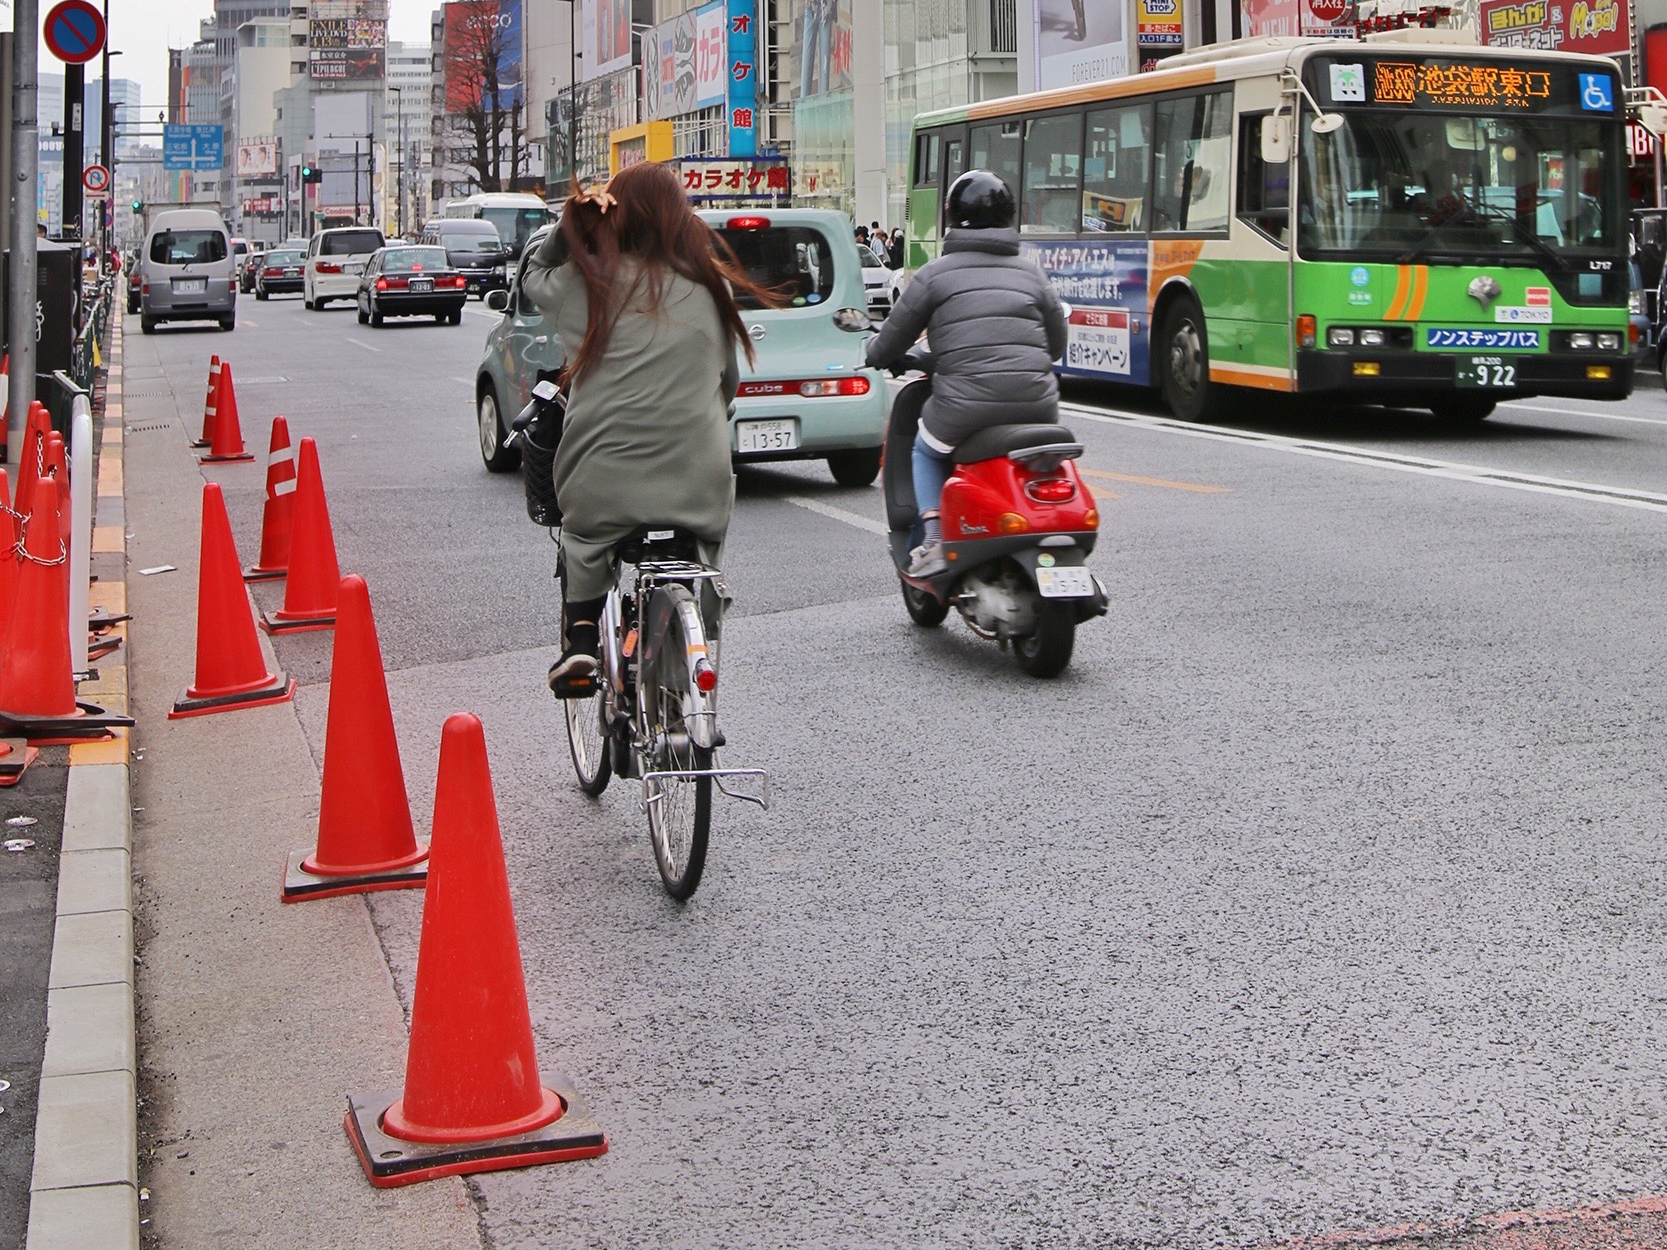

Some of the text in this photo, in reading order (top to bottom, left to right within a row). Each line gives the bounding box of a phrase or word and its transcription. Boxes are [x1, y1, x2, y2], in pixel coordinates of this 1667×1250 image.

[1149, 4, 1170, 13] STOP
[1490, 1, 1547, 31] まんが
[311, 20, 347, 30] EXILE
[311, 30, 329, 38] LIVE
[699, 26, 725, 83] カラ
[684, 167, 788, 190] カラオケ館
[1428, 330, 1539, 348] ノンステップバス
[745, 384, 784, 393] cube
